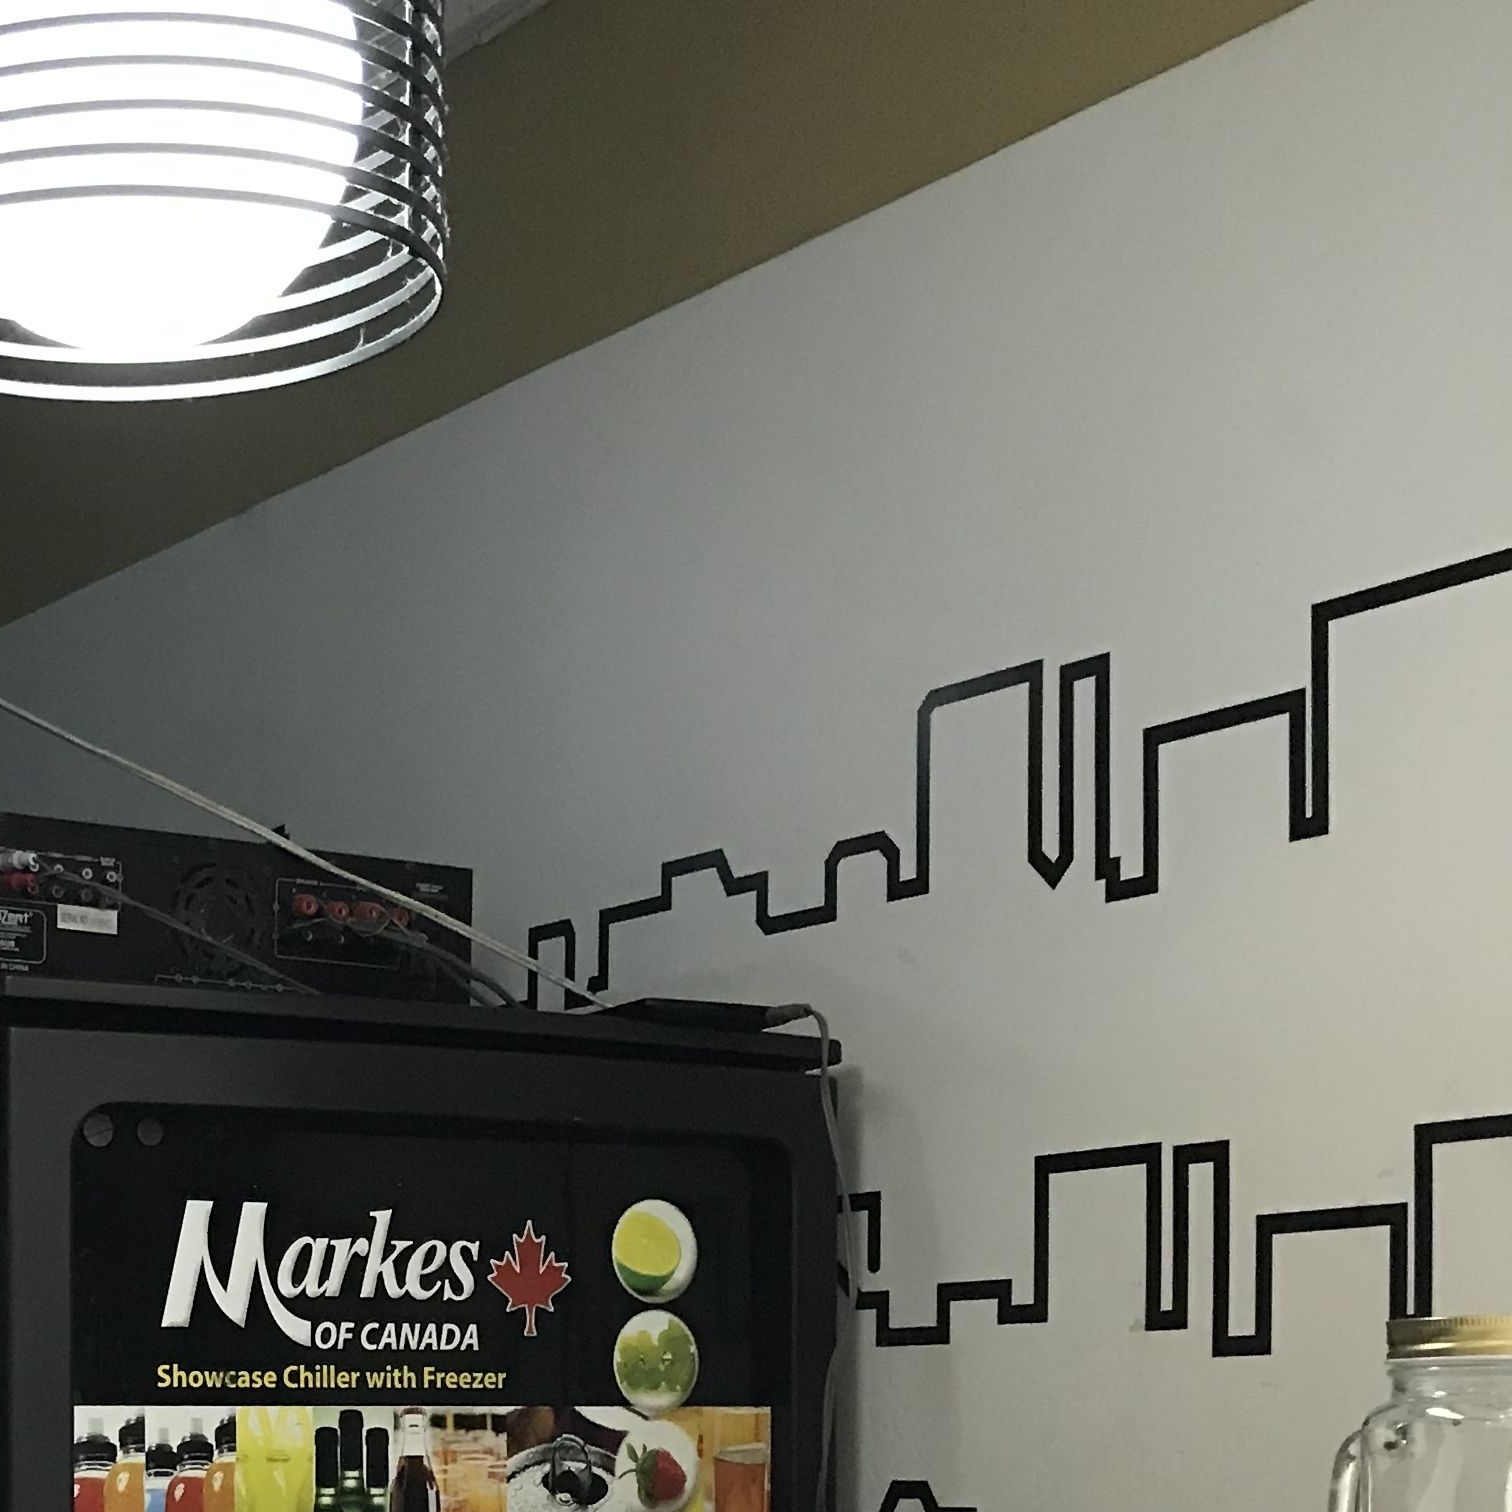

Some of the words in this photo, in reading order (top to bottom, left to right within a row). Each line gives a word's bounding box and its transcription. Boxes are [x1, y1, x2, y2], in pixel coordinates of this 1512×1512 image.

[160, 1199, 481, 1347] Markes
[314, 1321, 355, 1350] OF
[360, 1322, 480, 1351] CANADA
[156, 1362, 278, 1389] Showcase
[283, 1364, 361, 1389] Chiller
[365, 1365, 418, 1390] with
[423, 1366, 507, 1390] Freezer
